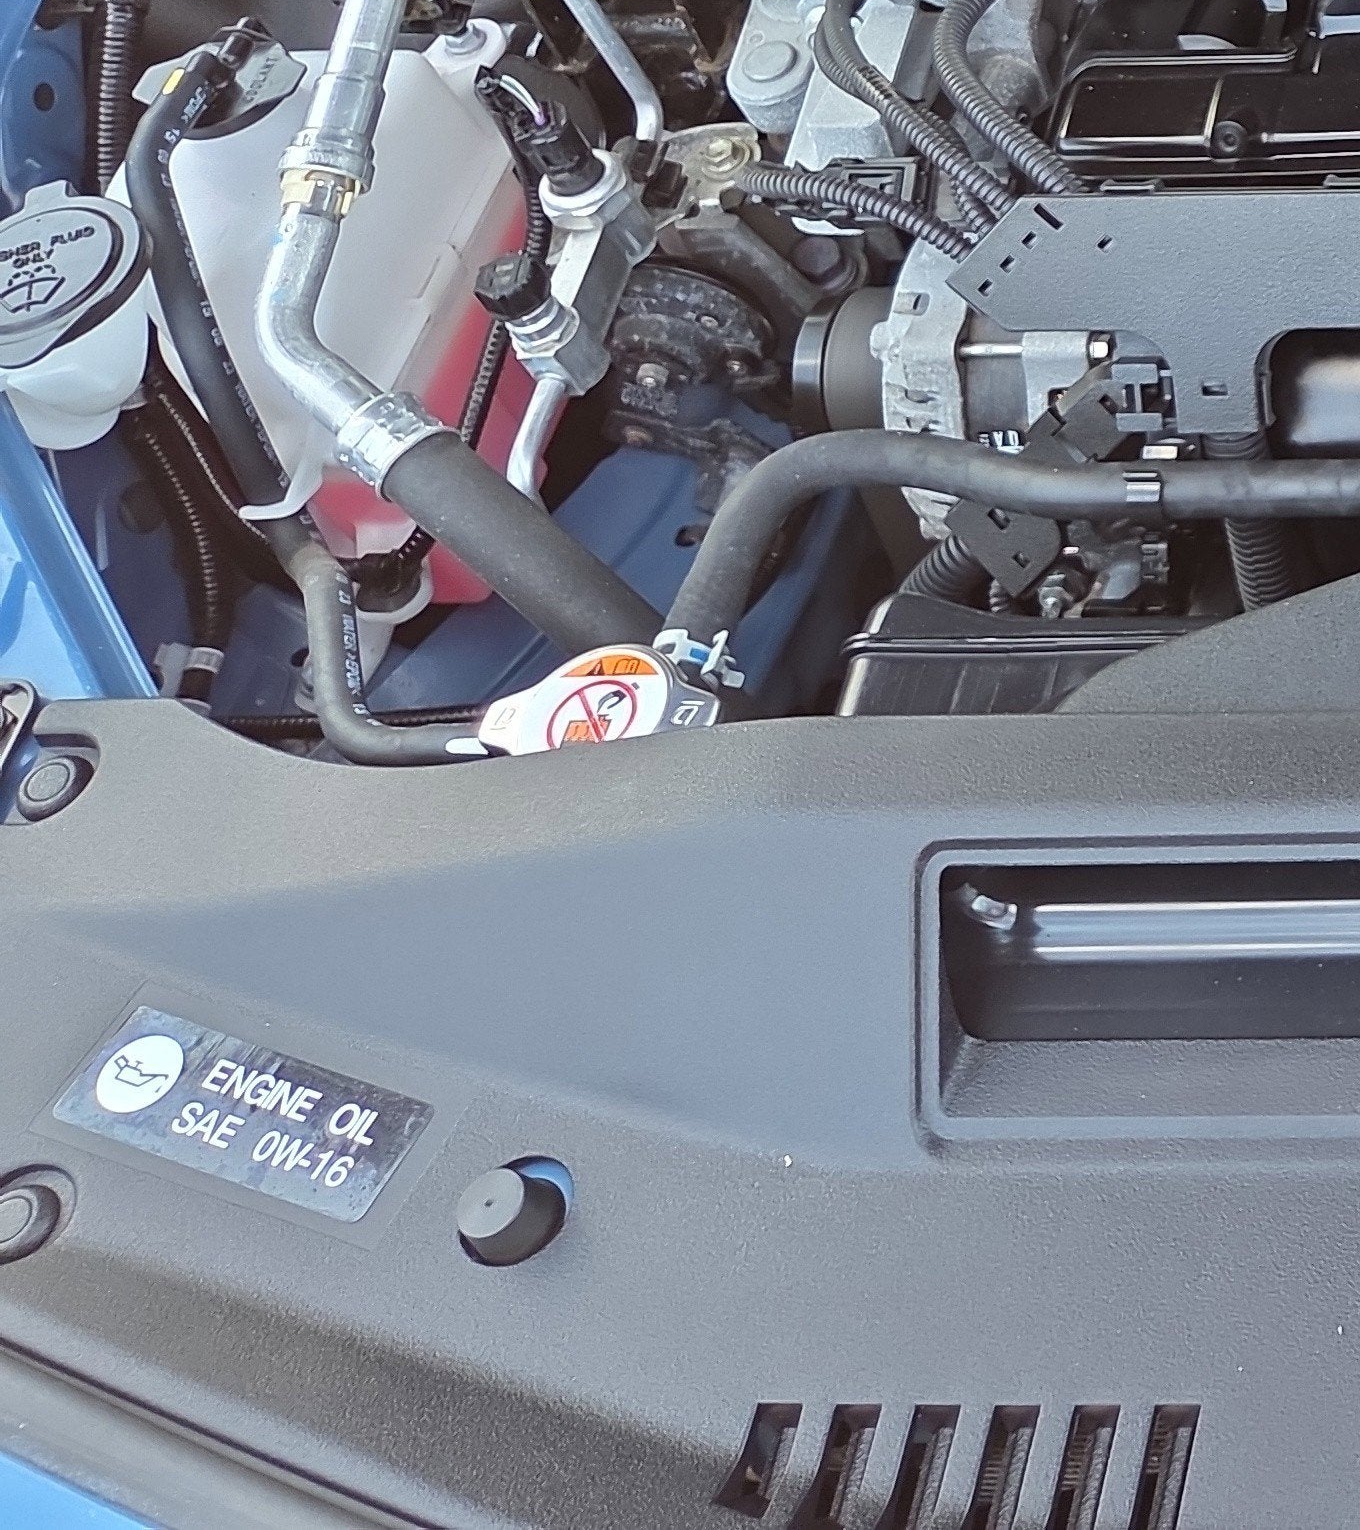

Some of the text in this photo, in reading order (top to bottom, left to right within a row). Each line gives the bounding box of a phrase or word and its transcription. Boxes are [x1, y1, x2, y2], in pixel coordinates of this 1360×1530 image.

[13, 248, 54, 269] ONLY
[172, 1101, 356, 1188] SAE 0W-16
[202, 1058, 379, 1146] ENGINE OIL
